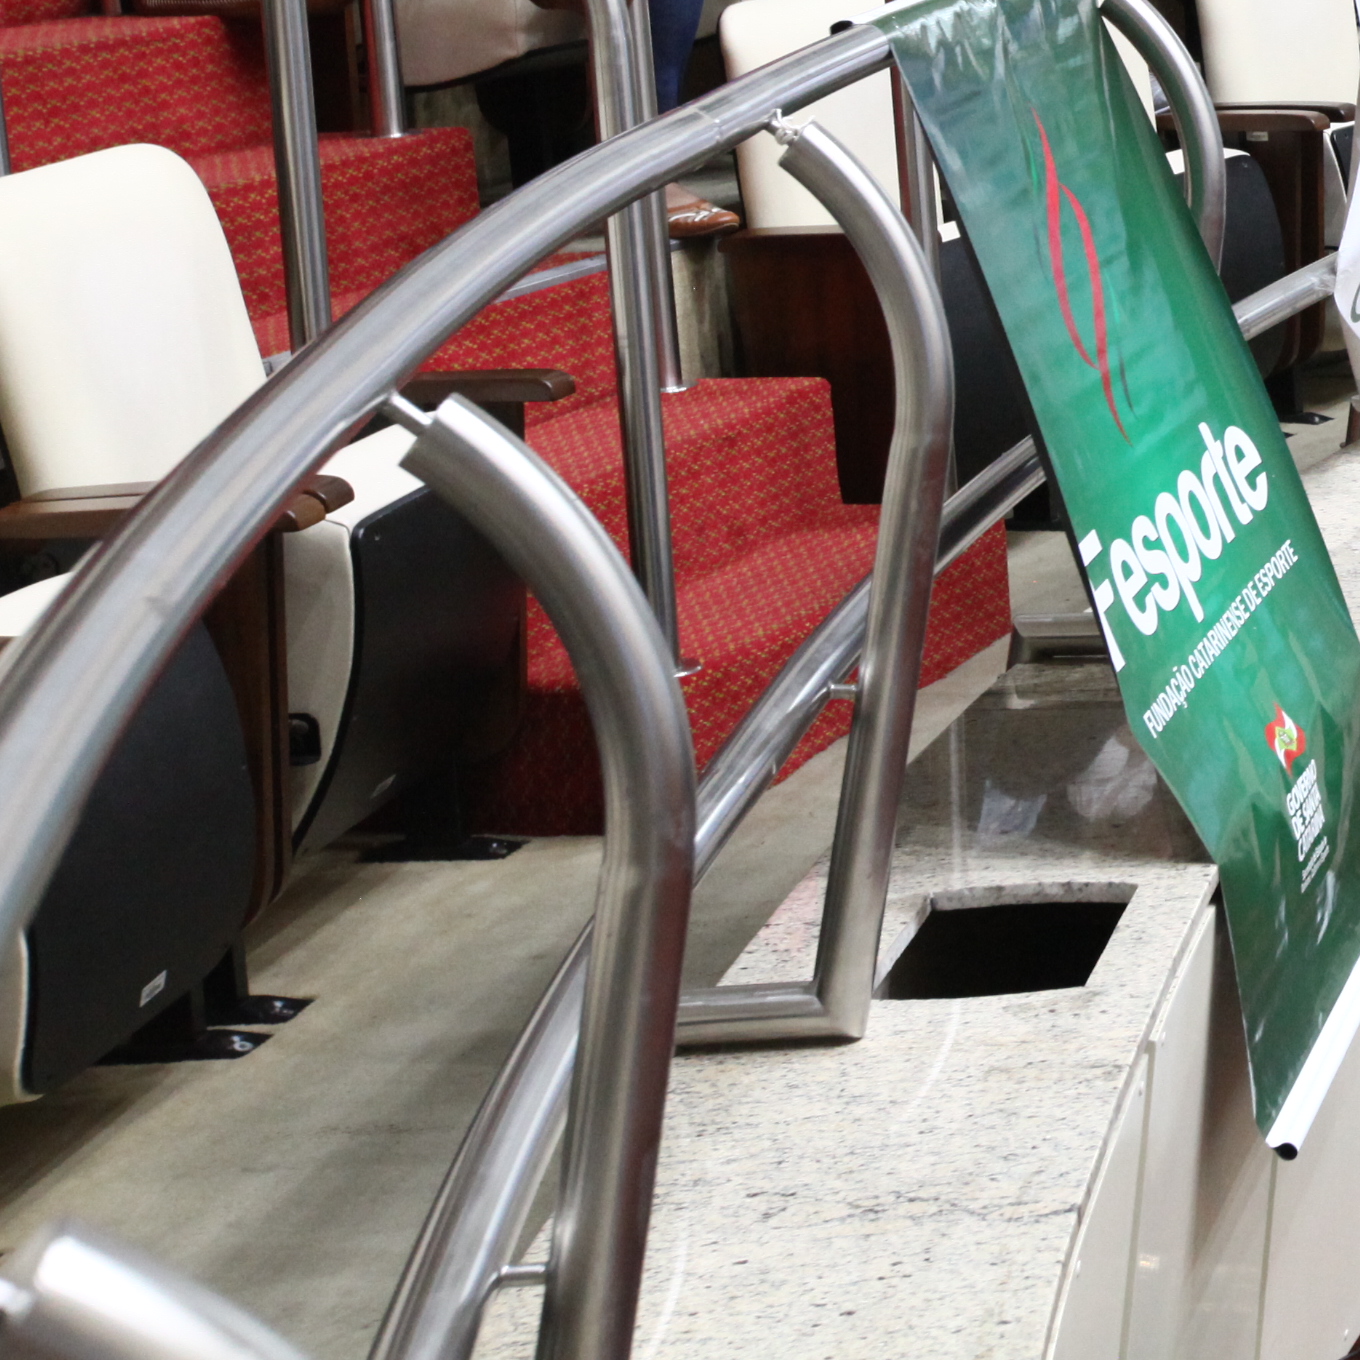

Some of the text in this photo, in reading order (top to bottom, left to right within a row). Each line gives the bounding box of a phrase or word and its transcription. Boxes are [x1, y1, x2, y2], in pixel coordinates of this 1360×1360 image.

[1143, 538, 1299, 739] FUNDAÇÃO CATARINENSE DE ESPORTE
